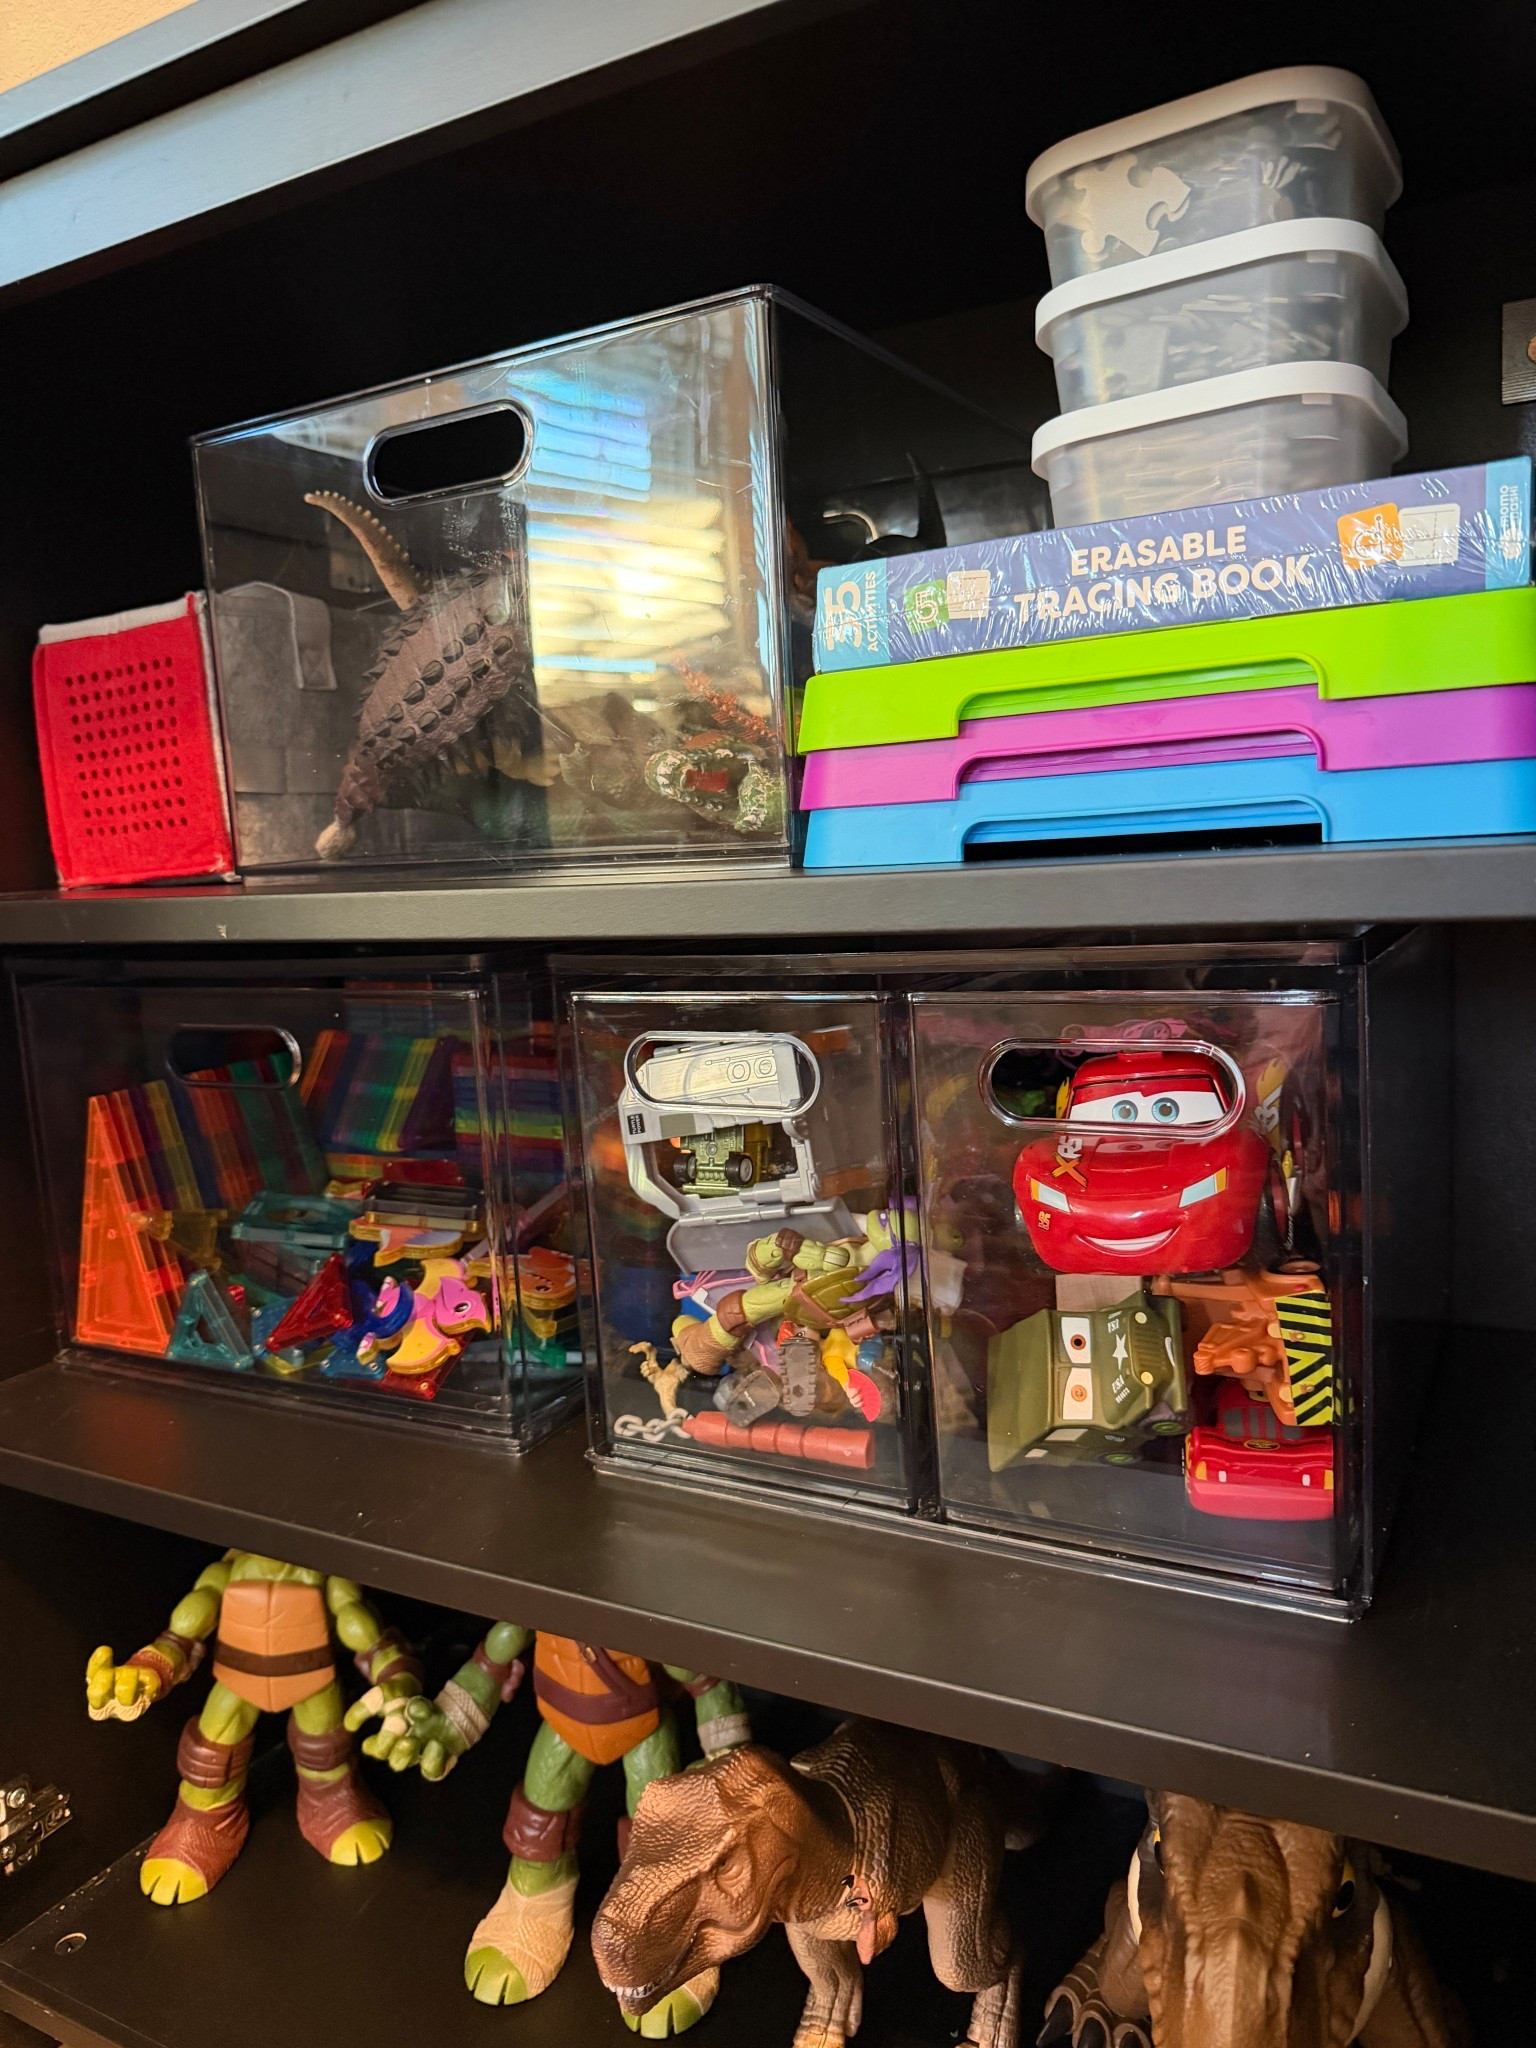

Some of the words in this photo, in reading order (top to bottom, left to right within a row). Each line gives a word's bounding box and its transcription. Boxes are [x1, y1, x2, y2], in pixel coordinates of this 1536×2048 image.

[1070, 525, 1247, 577] ERASABLE
[824, 581, 862, 651] 35
[865, 571, 879, 652] ACTIVITIES
[915, 591, 939, 623] 5
[1013, 572, 1181, 624] TRACING
[1193, 554, 1314, 600] BOOK
[1038, 1211, 1051, 1231] 95
